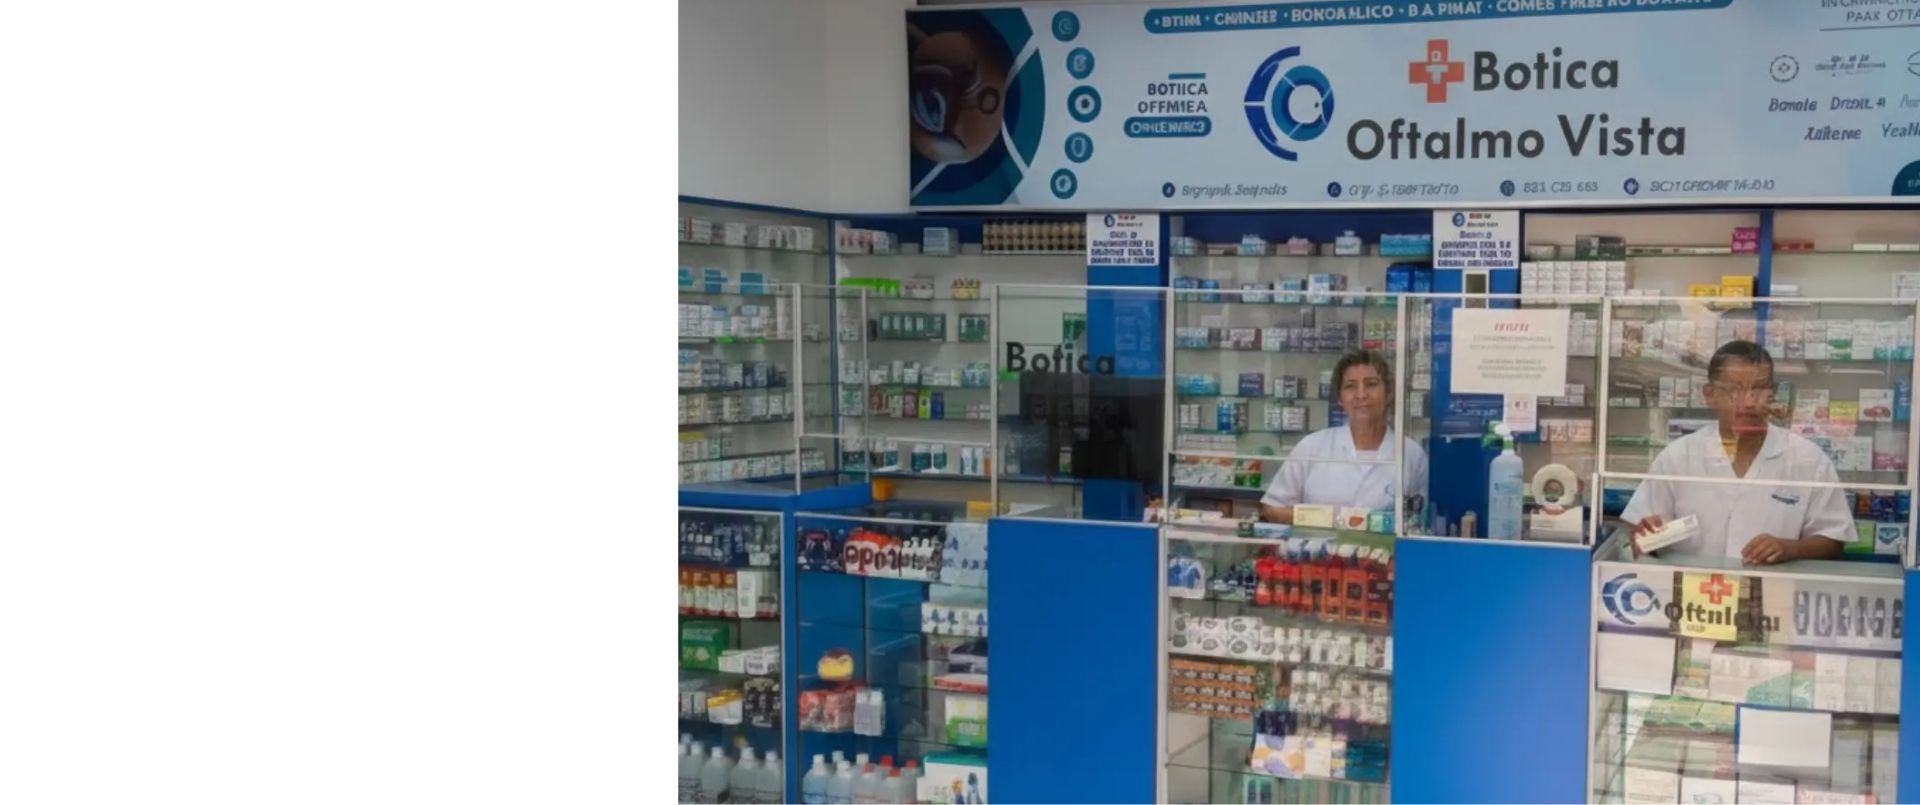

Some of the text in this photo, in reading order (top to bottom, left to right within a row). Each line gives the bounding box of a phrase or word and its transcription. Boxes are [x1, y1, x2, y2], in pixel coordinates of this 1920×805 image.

[1473, 47, 1620, 91] Botica
[1346, 113, 1686, 160] Oftalmo Vista
[1006, 342, 1115, 374] Botica
